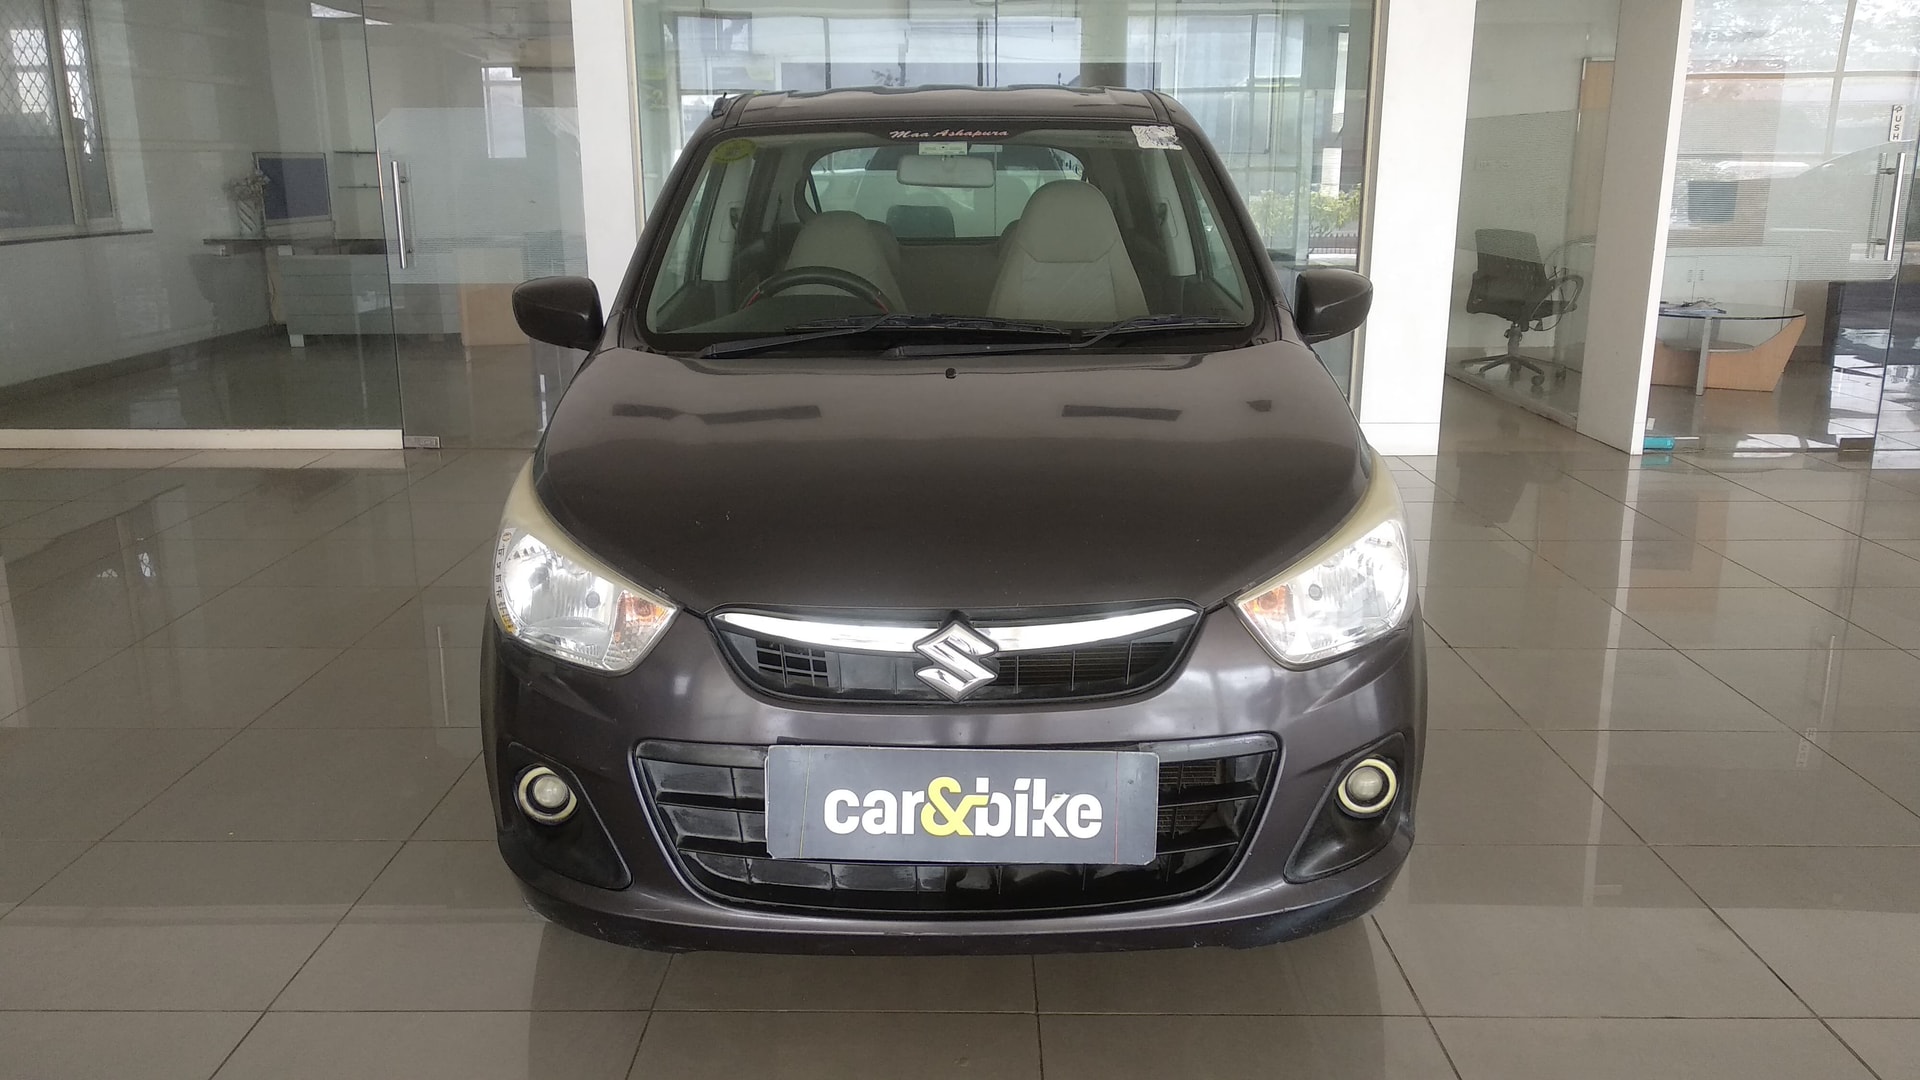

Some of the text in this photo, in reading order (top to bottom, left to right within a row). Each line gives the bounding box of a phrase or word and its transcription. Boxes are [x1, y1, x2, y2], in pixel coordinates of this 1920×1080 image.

[889, 128, 1008, 139] Maa Ashapura
[824, 776, 1103, 839] car&bike
